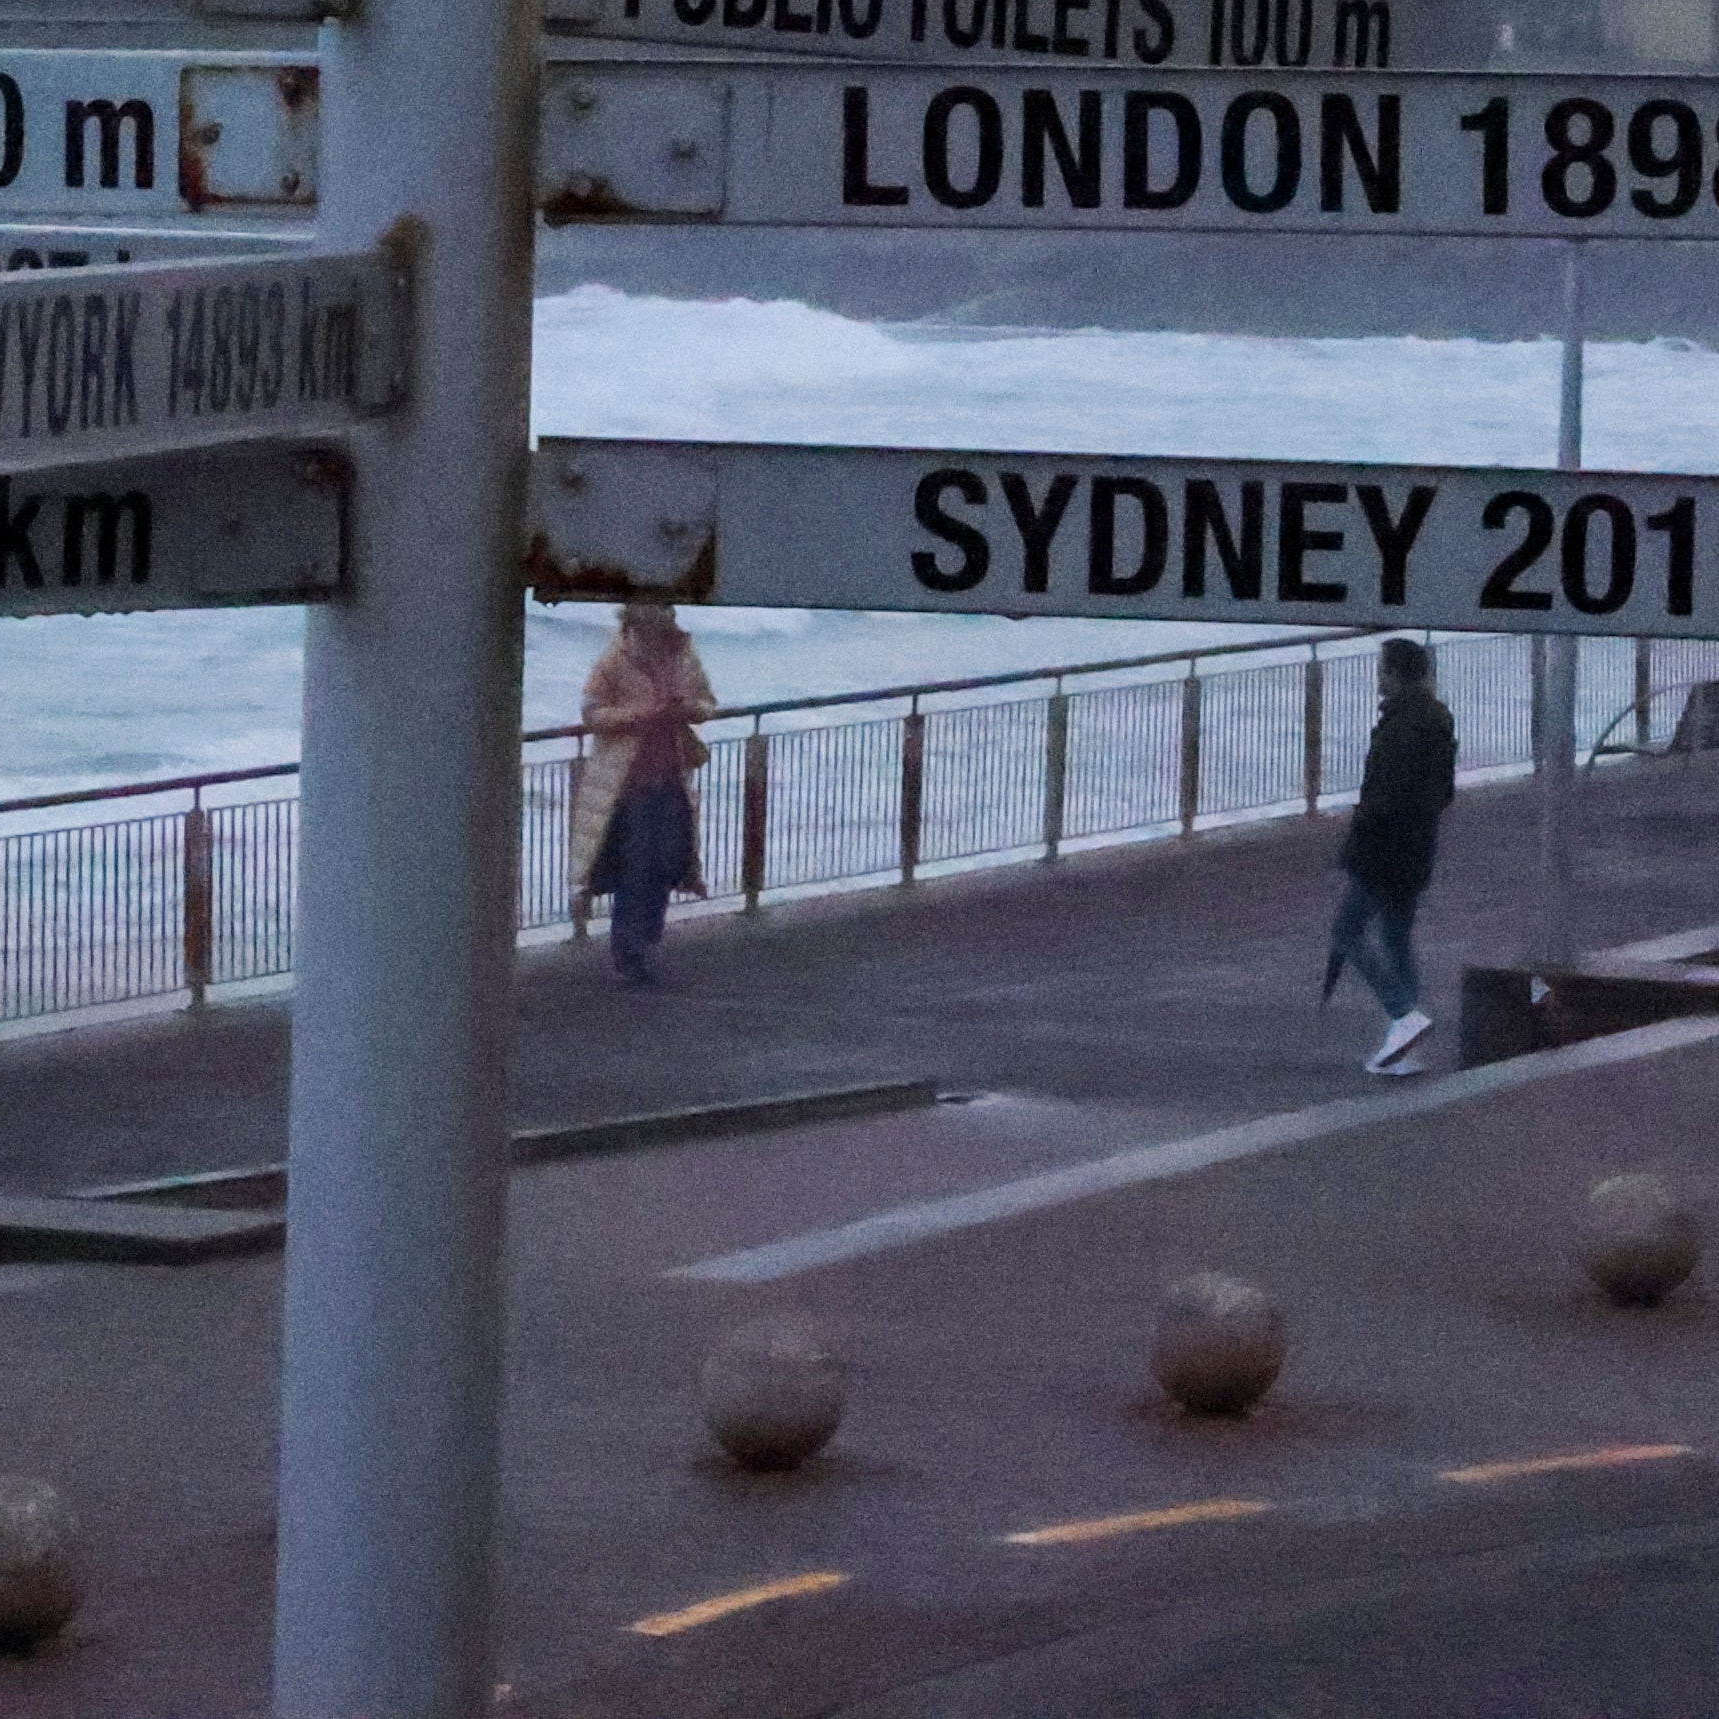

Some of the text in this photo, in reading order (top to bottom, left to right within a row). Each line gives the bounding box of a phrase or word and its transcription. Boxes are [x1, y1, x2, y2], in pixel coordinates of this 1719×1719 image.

[68, 98, 154, 190] m
[841, 85, 1402, 213] LONDON
[298, 278, 357, 400] km
[912, 469, 1432, 605] SYDNEY
